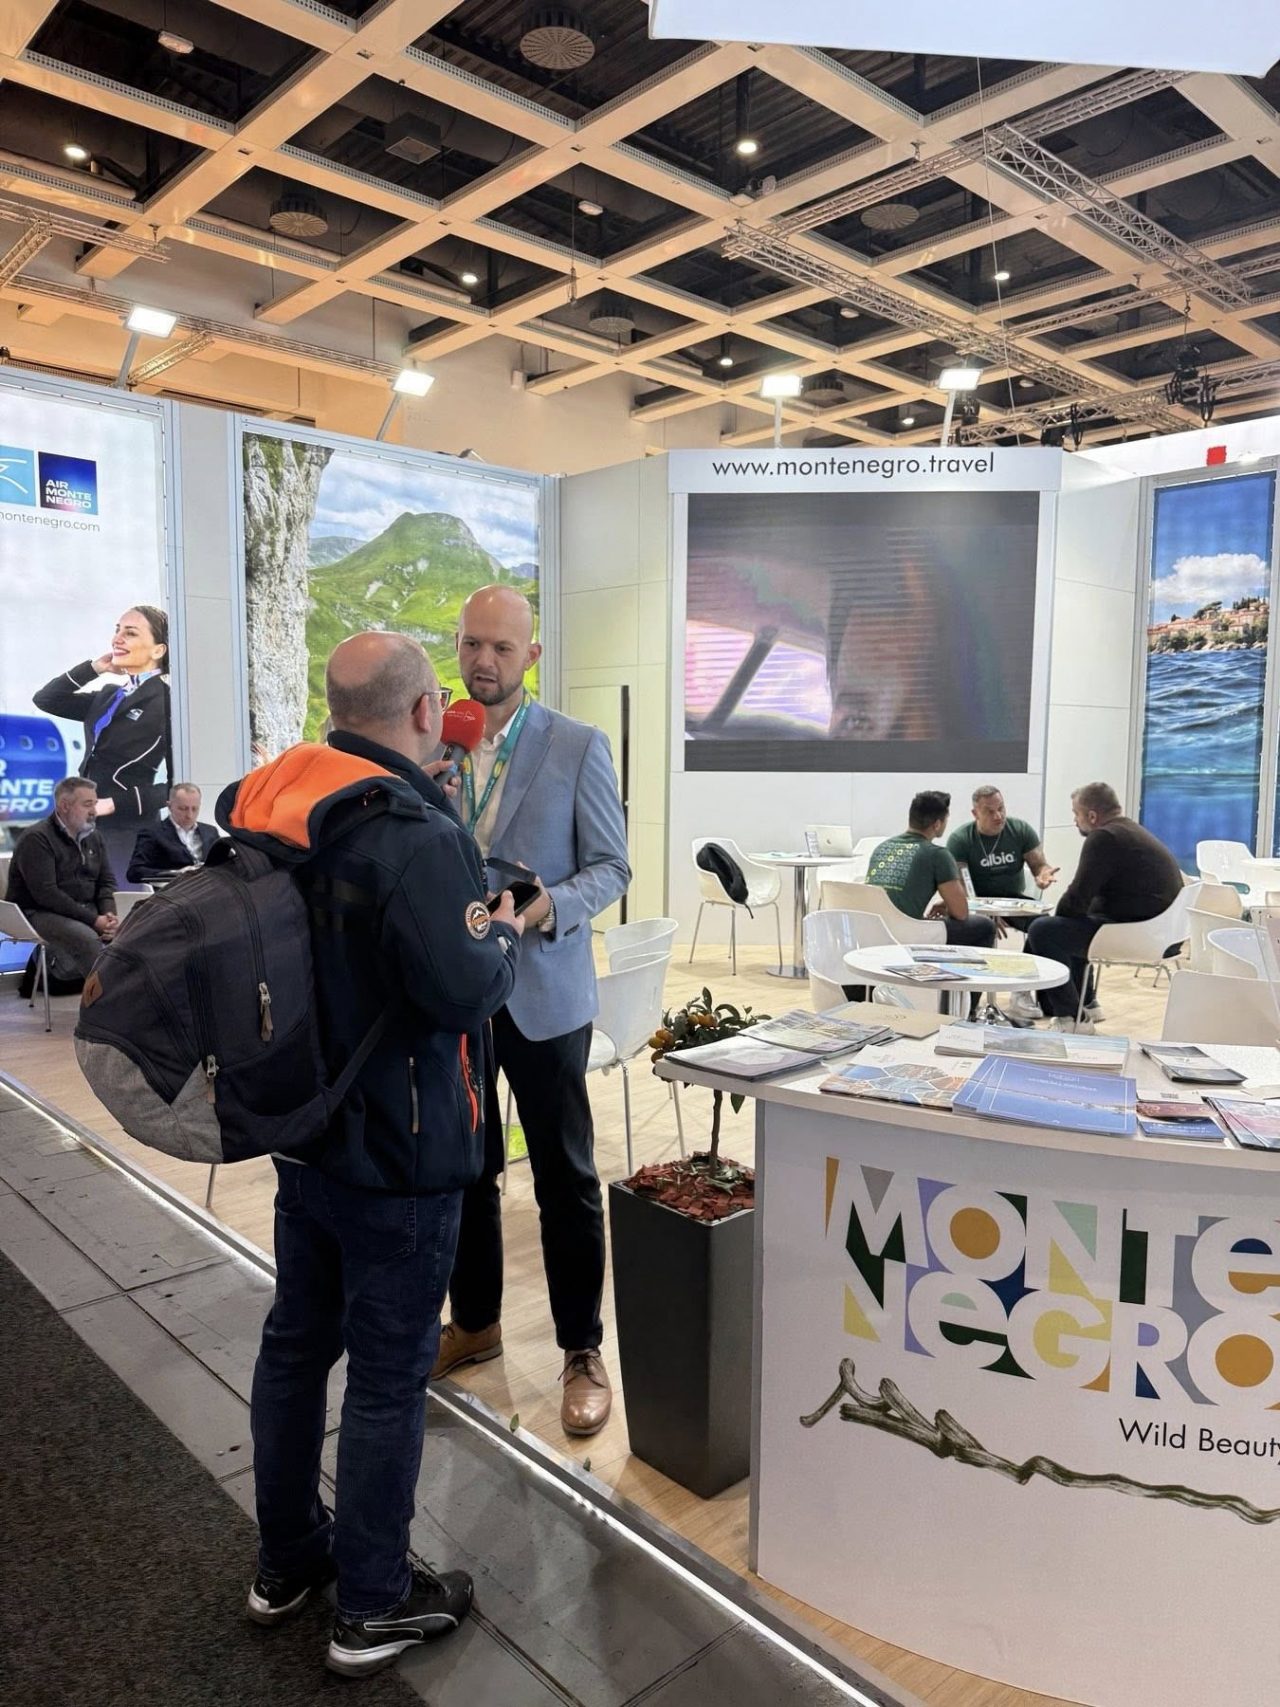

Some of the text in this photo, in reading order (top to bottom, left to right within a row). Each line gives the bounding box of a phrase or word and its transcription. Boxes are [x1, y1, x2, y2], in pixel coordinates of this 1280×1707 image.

[712, 451, 995, 479] www.montenegro.travel
[45, 479, 69, 490] AIR
[45, 487, 92, 501] MONTE
[45, 495, 92, 509] NEGRO
[980, 851, 1015, 868] albia
[1118, 1417, 1186, 1450] Wild
